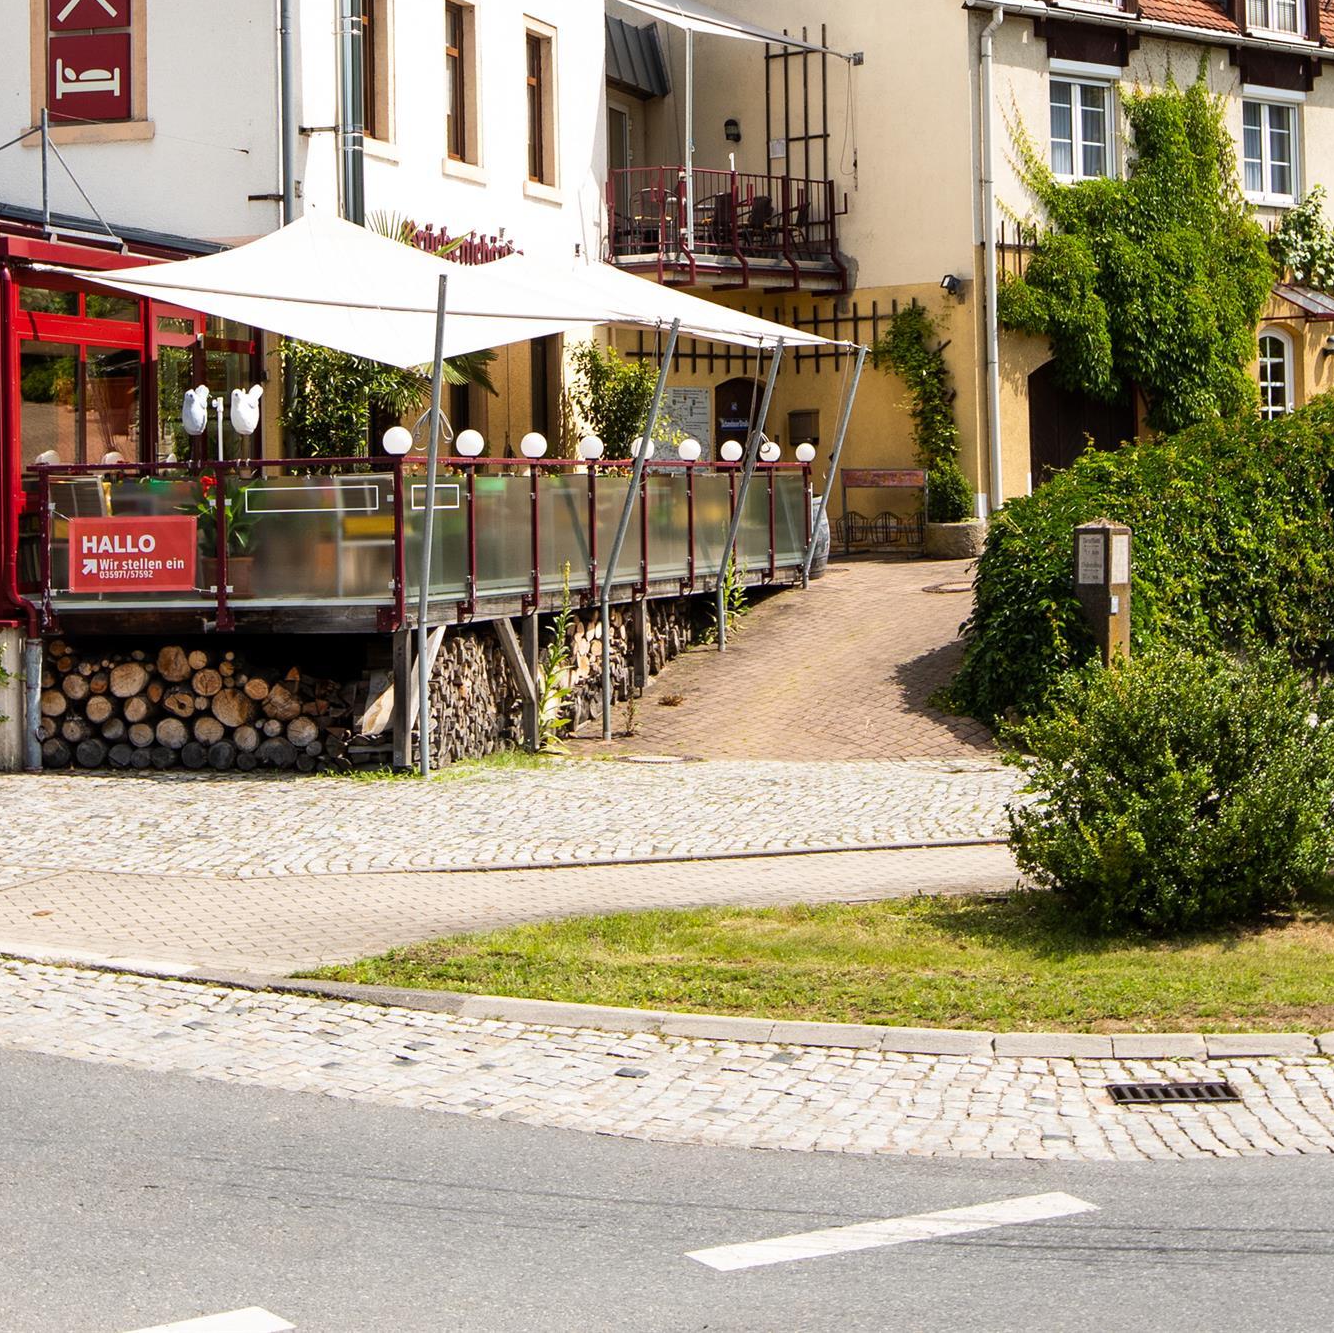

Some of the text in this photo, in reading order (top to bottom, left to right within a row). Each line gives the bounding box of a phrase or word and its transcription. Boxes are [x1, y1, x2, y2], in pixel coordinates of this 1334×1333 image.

[82, 534, 156, 554] HALLO
[99, 557, 185, 571] Wir stellen ein
[99, 569, 153, 579] 035971/57592
